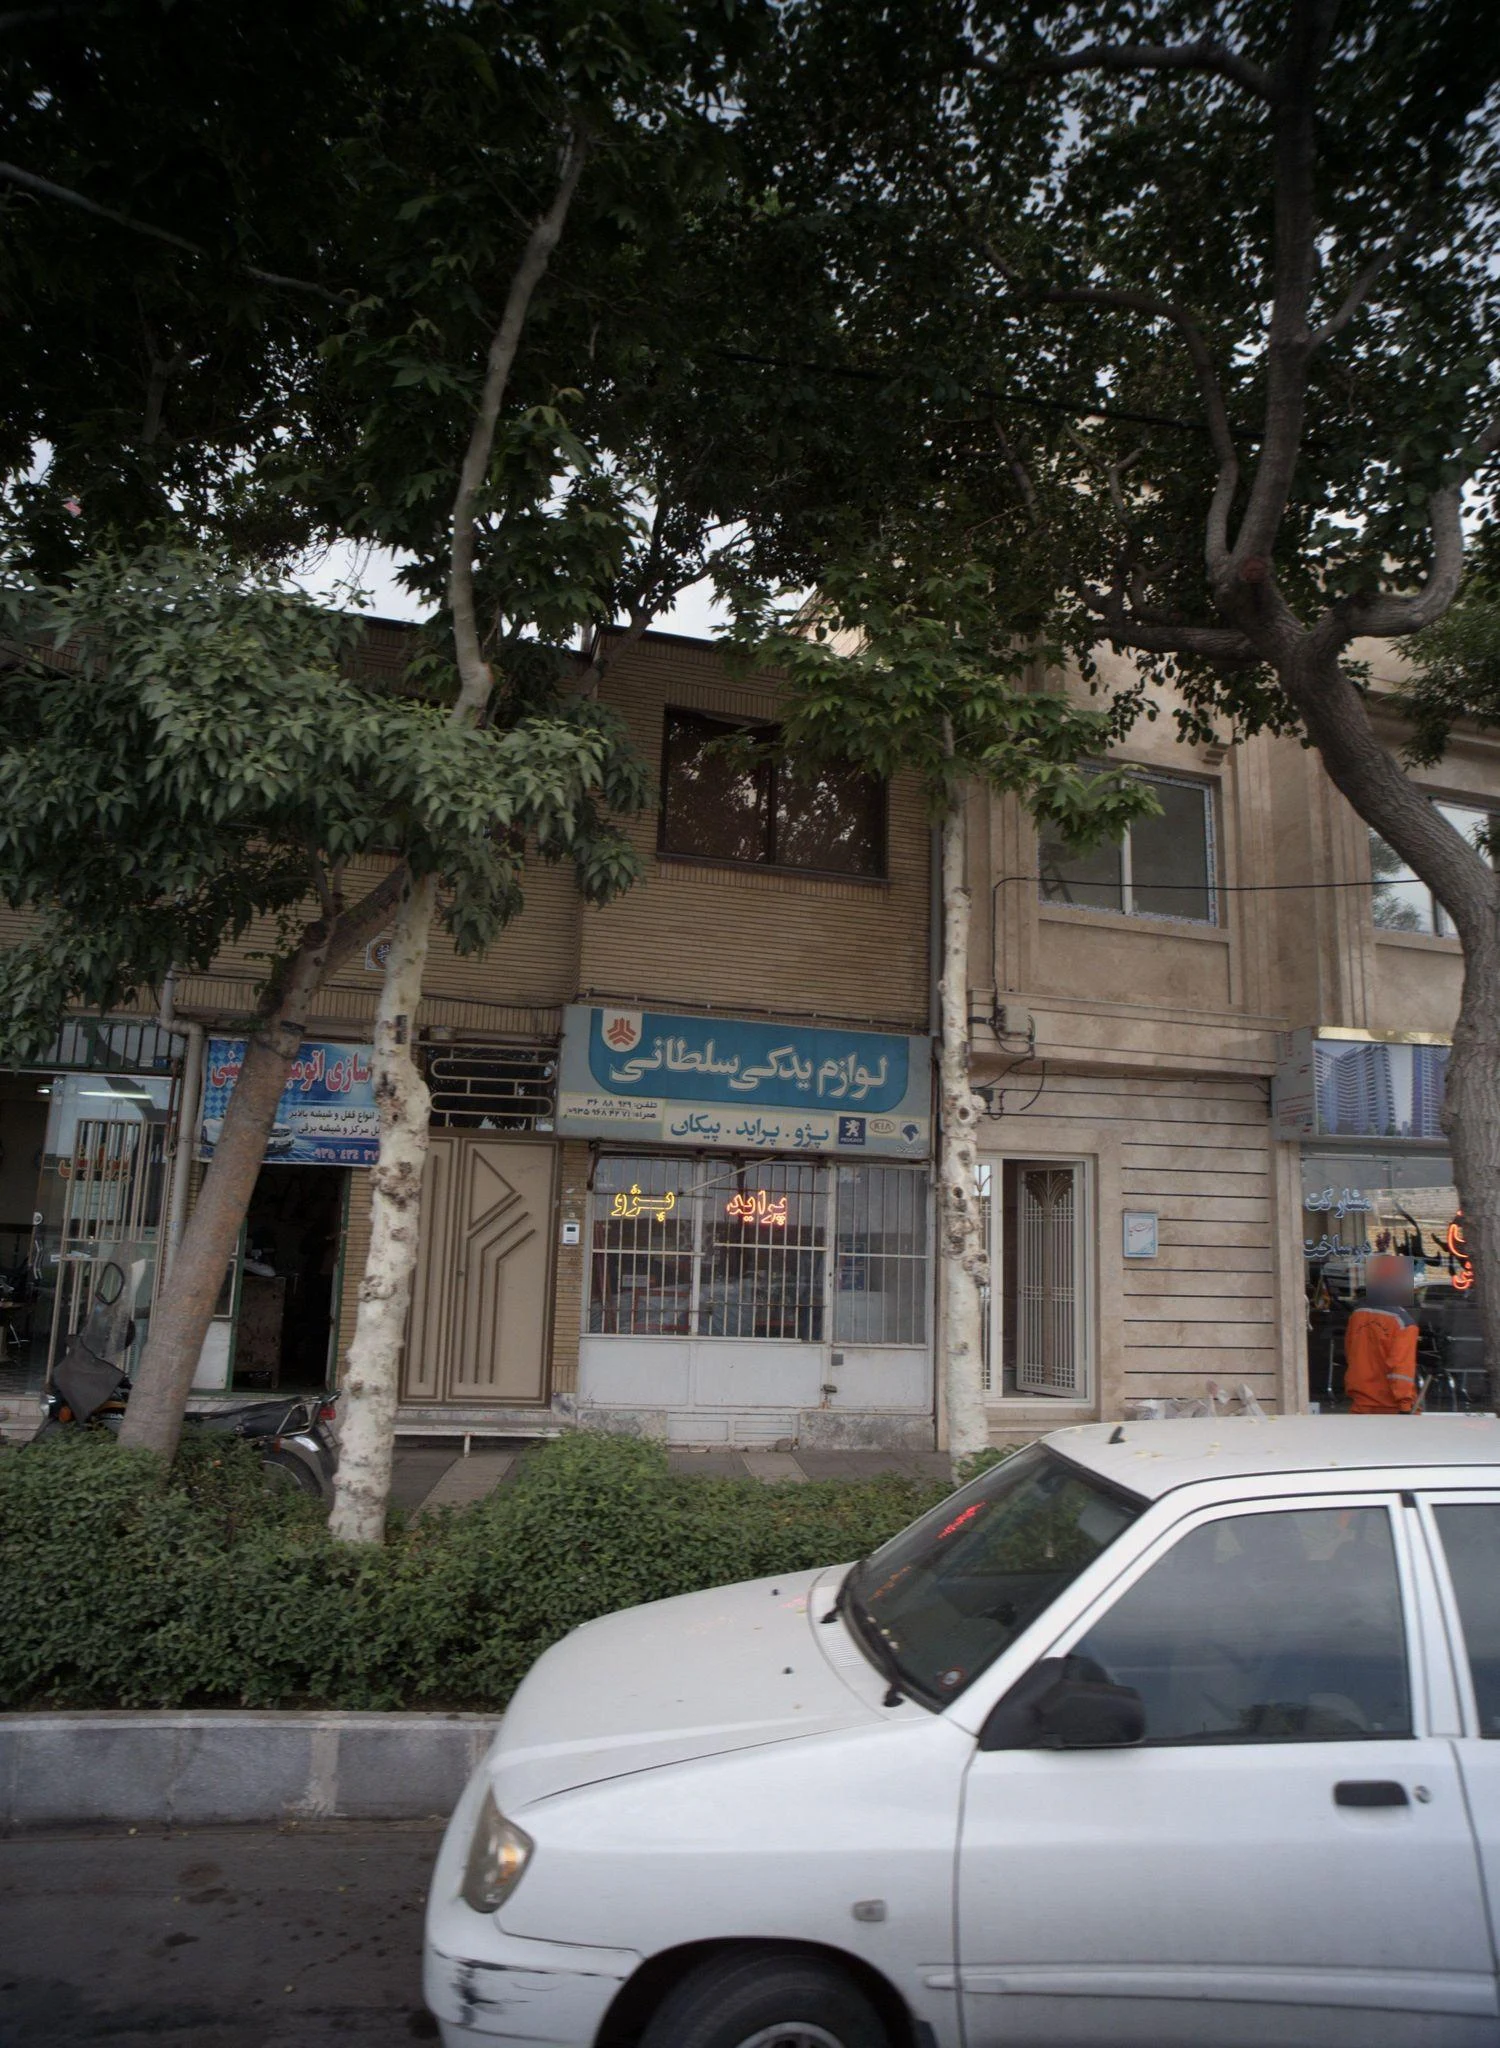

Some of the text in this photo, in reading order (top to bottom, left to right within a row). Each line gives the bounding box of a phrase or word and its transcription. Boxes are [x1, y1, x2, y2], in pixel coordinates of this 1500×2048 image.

[609, 1037, 887, 1098] لوازم یدکی سلطانی
[670, 1113, 829, 1148] پژو پراید پیکان
[611, 1184, 676, 1222] پژو
[726, 1189, 788, 1227] پراید
[1304, 1188, 1374, 1218] مشارکت
[1303, 1234, 1353, 1259] ساخت
